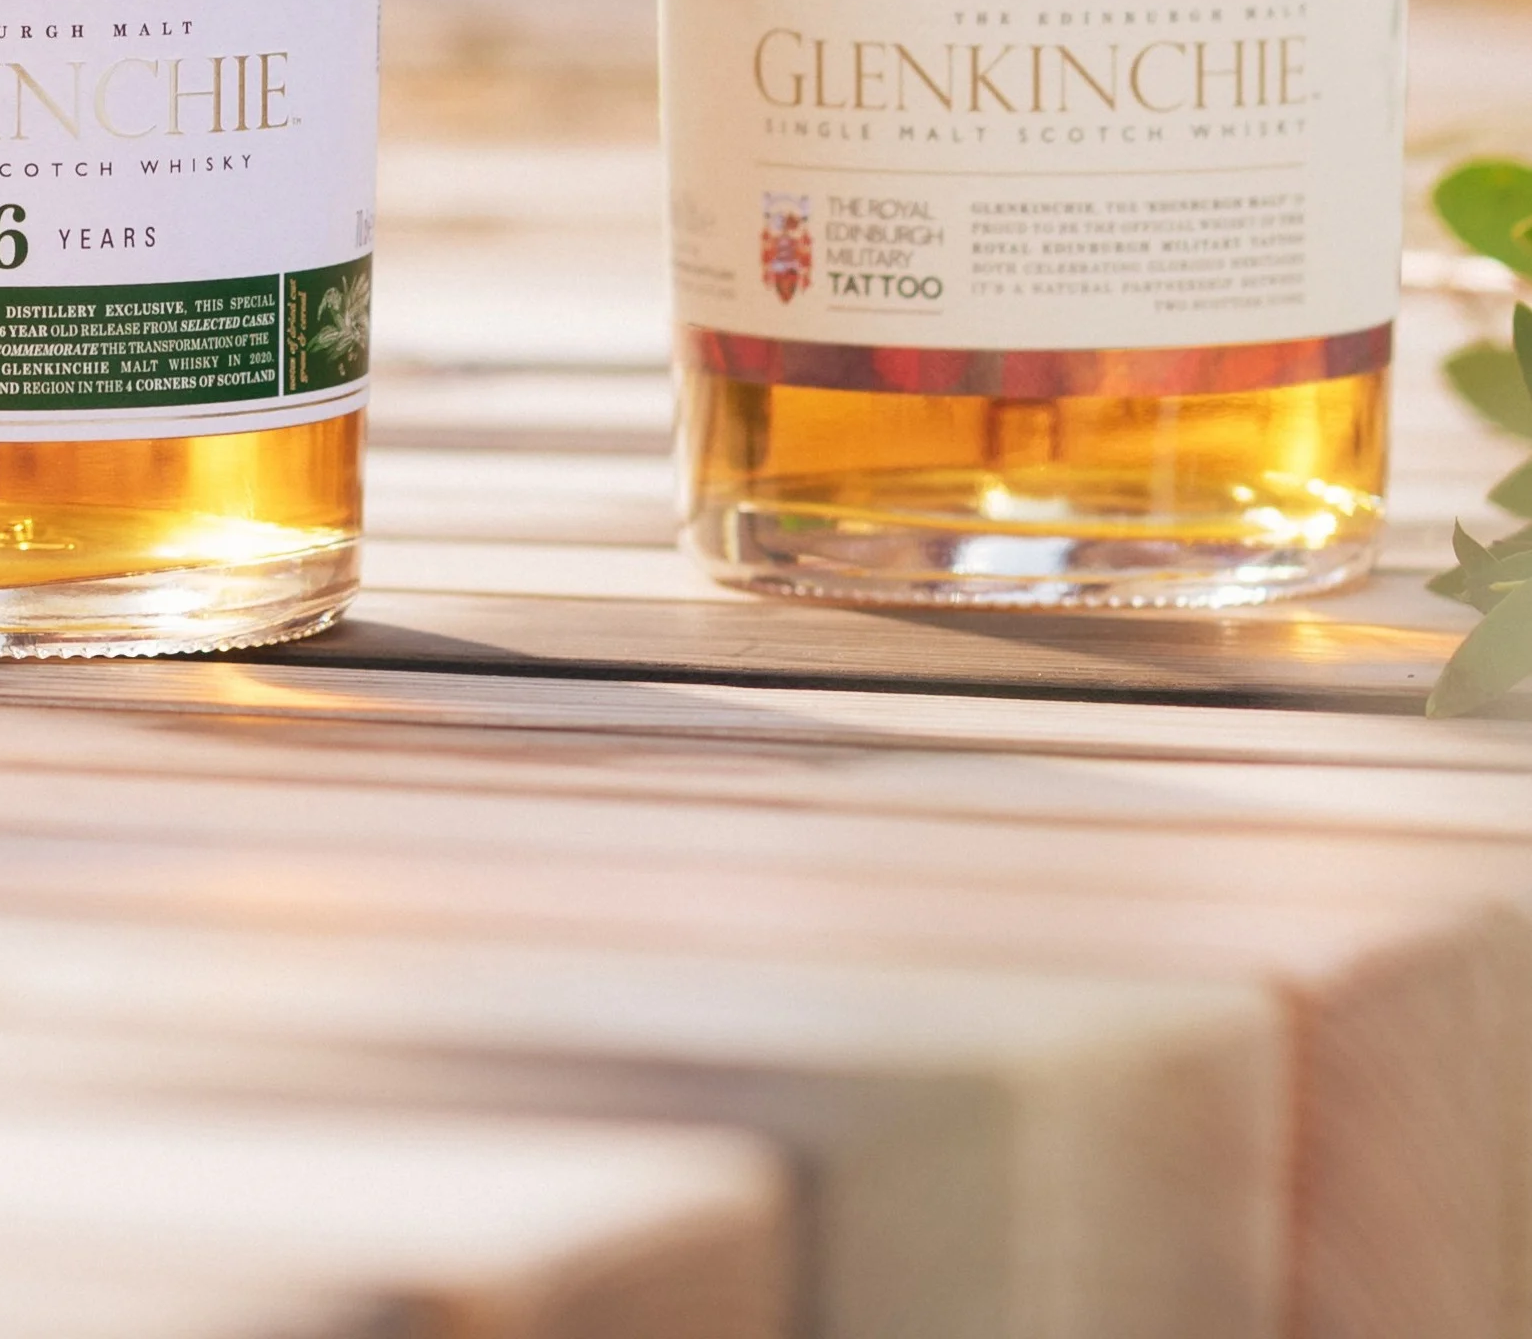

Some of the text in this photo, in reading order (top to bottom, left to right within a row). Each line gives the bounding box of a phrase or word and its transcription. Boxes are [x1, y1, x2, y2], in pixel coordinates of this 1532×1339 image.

[113, 21, 192, 37] MALT
[955, 12, 1011, 26] THE
[1039, 9, 1223, 26] EDINBURGH
[753, 27, 1306, 114] GLENKINCHIE
[765, 119, 1306, 144] SINGLE MALT SCOTCH WHISKY
[140, 154, 251, 174] WHISKY
[828, 196, 935, 220] THE ROYAL
[59, 226, 156, 250] YEARS
[826, 222, 943, 246] EDINBURGH
[827, 248, 914, 268] MILITARY
[828, 272, 943, 300] TATTOO
[6, 305, 97, 318] DISTILLERY
[105, 301, 188, 317] EXCLUSIVE,
[195, 298, 224, 313] THIS
[230, 294, 275, 310] SPECIAL
[8, 325, 48, 338] YEAR
[50, 324, 78, 337] OLD
[80, 322, 141, 337] RELEASE
[143, 321, 178, 335] FROM
[179, 317, 241, 333] SELECTED
[242, 312, 275, 328] CASKS
[100, 342, 127, 355] THE
[128, 335, 234, 354] TRANSFORMATION
[235, 334, 249, 347] OF
[250, 332, 269, 345] THE
[1, 361, 109, 376] GLENKINCHIE
[120, 359, 158, 374] MALT
[168, 355, 219, 371] WHISKY
[228, 354, 241, 367] IN
[22, 380, 75, 395] REGION
[77, 380, 93, 393] IN
[95, 380, 123, 393] THE
[125, 379, 132, 392] 4
[135, 375, 197, 392] CORNERS
[198, 374, 215, 388] OF
[217, 369, 275, 387] SCOTLAND
